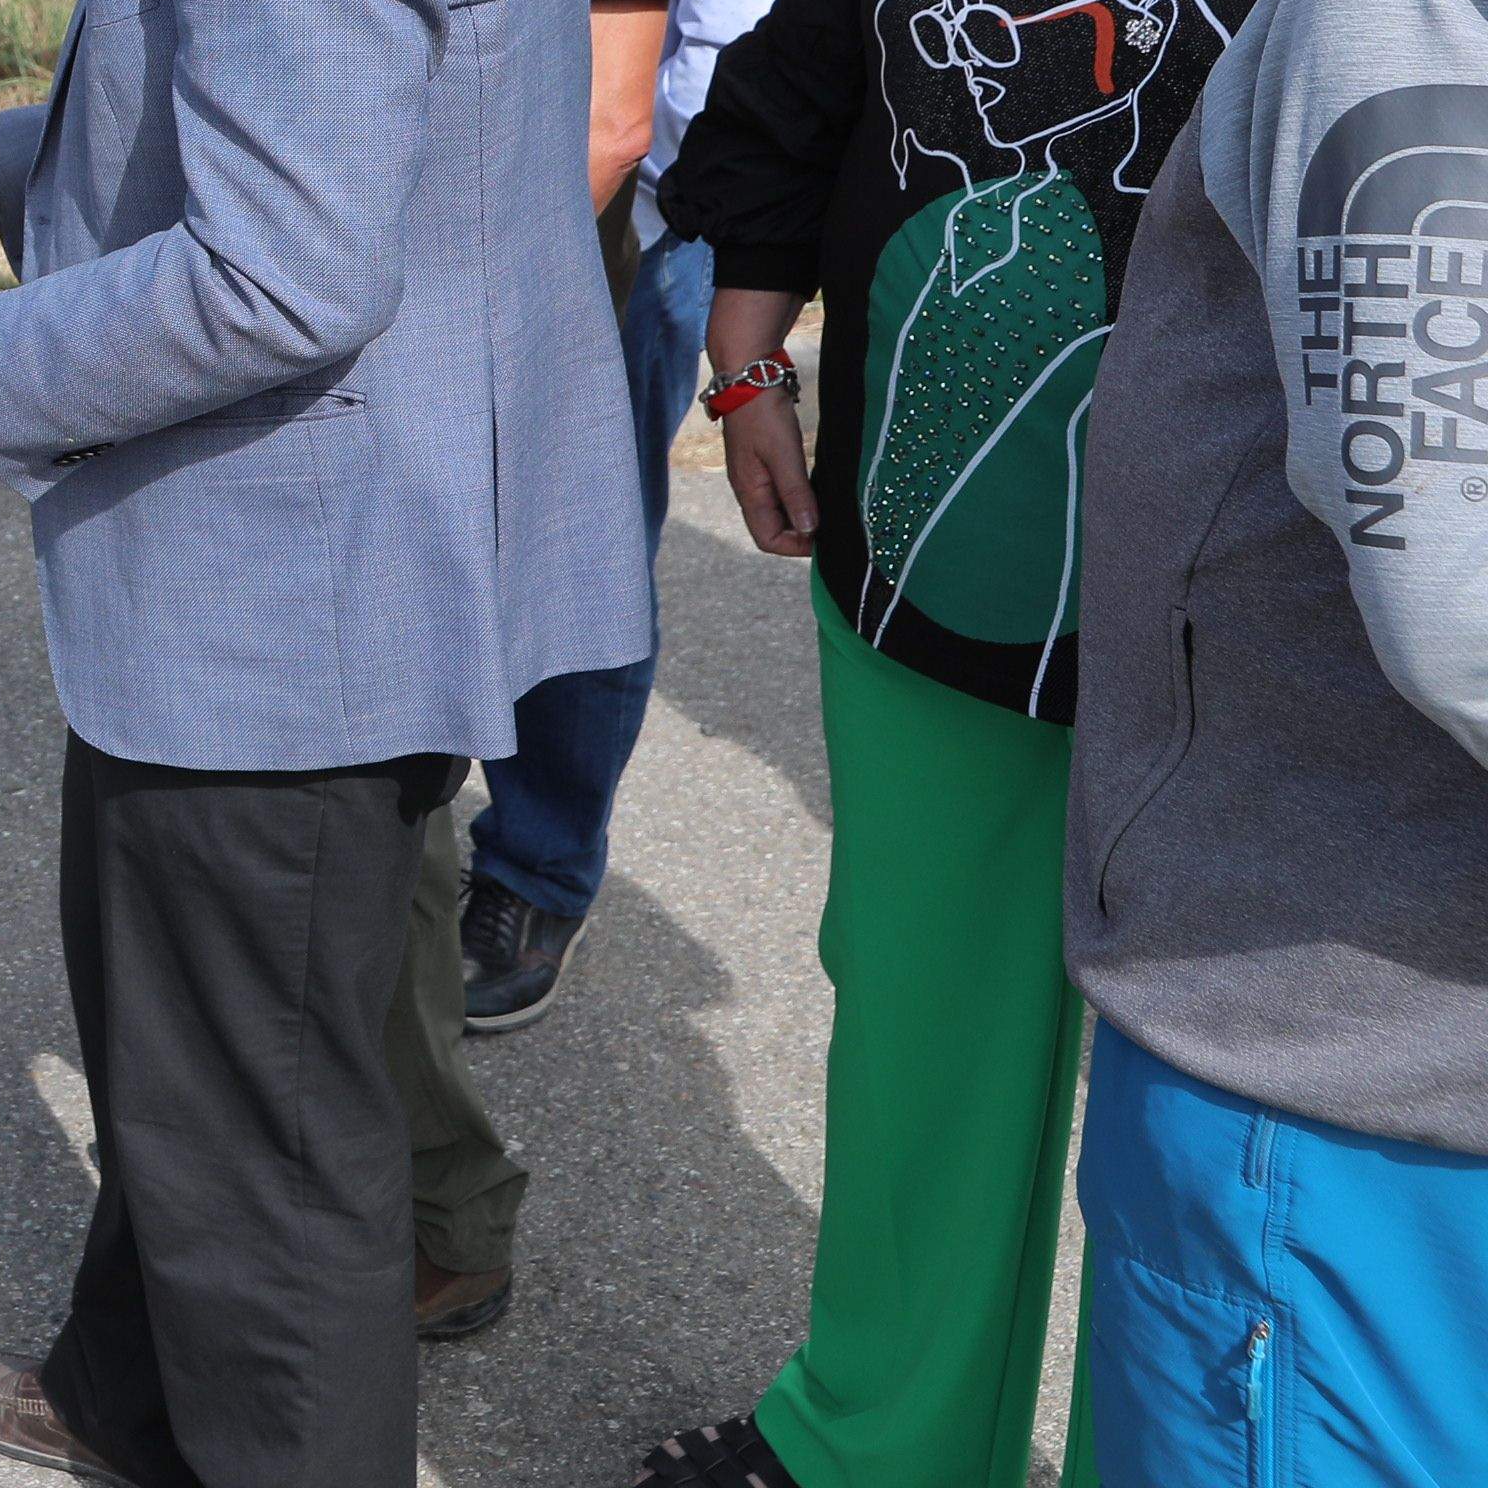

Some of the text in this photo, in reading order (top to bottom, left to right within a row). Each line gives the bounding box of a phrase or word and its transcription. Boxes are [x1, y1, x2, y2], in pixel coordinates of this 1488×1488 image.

[1297, 244, 1341, 405] THE
[1341, 244, 1412, 550] NORTH
[1410, 244, 1488, 464] FACE
